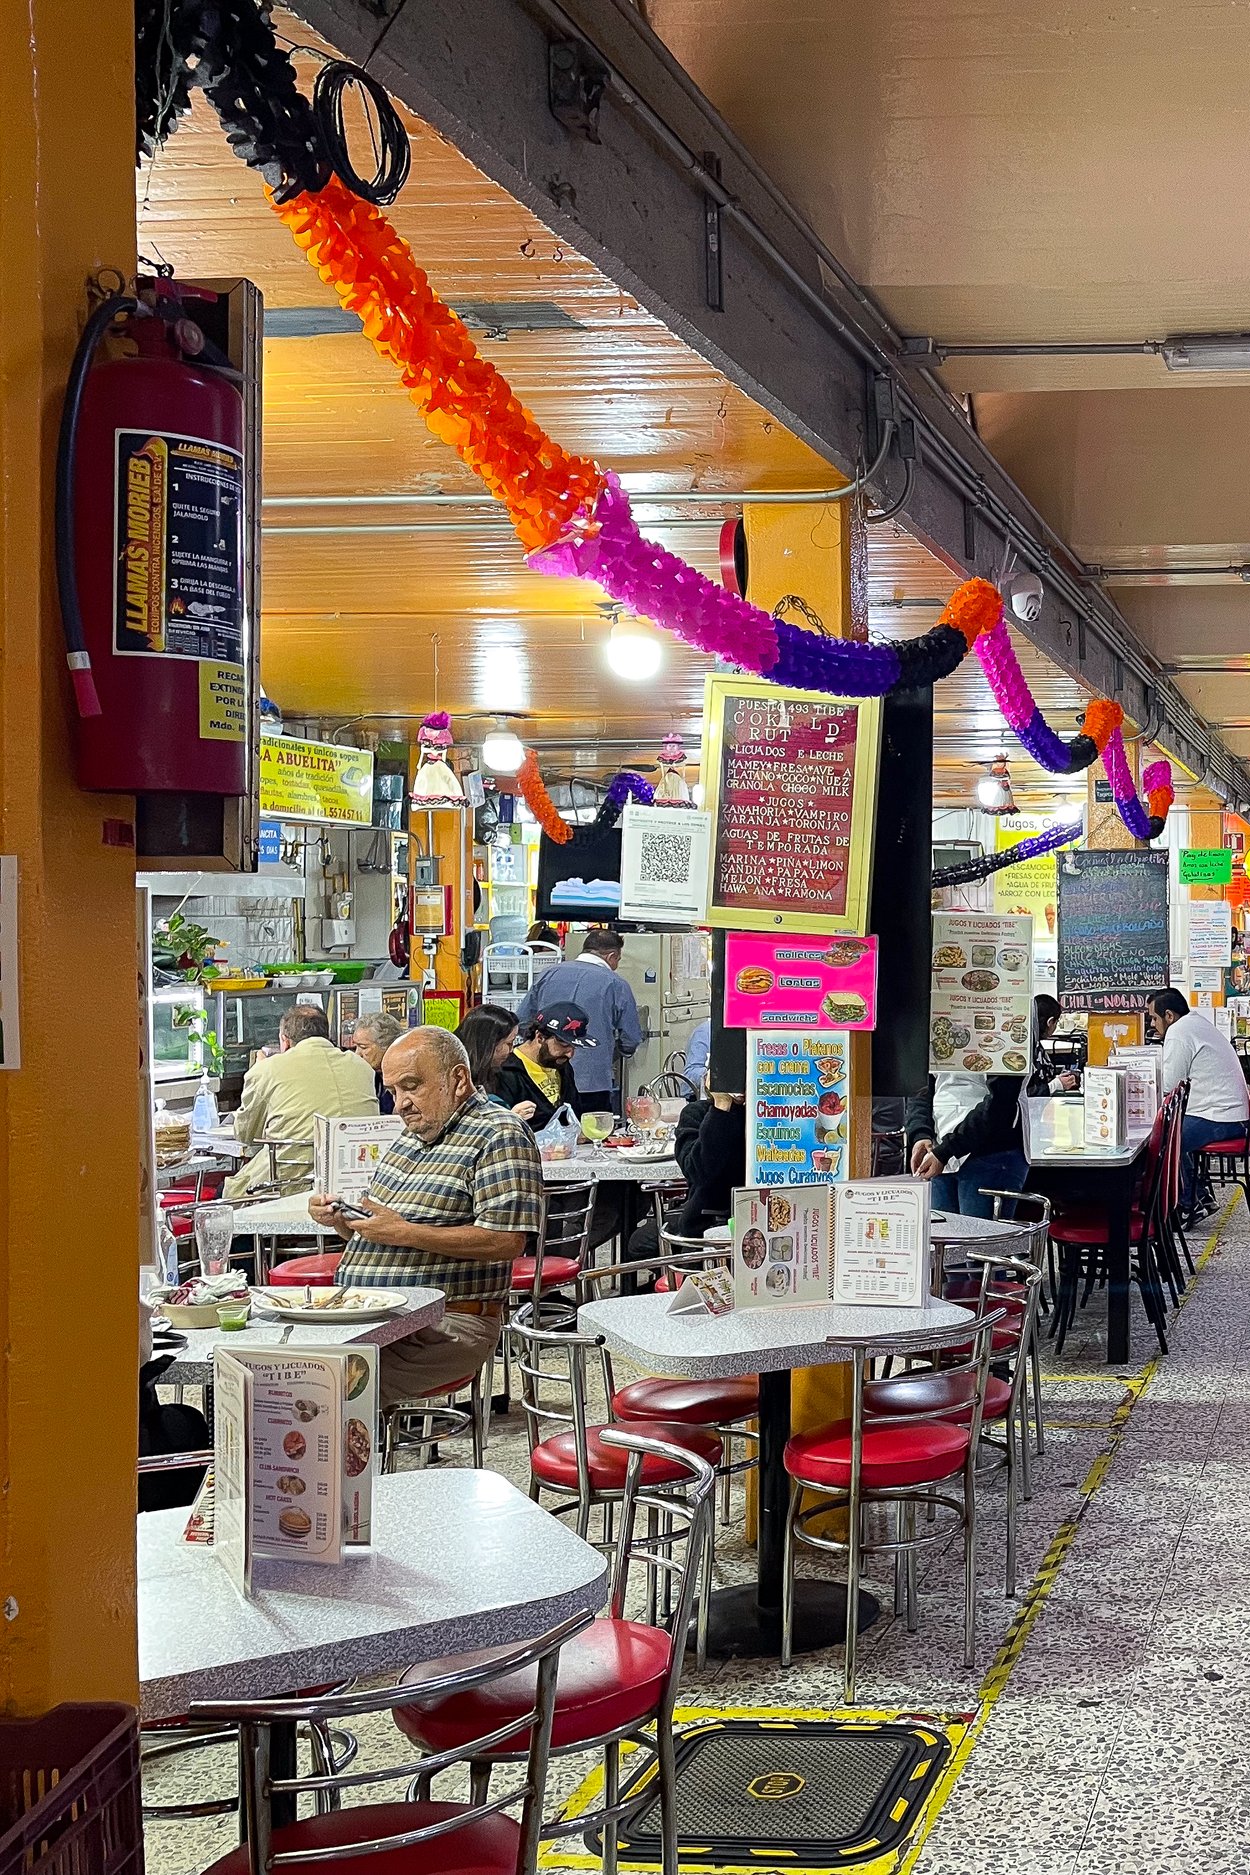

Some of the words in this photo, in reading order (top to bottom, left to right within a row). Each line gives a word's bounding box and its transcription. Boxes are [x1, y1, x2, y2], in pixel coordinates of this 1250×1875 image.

[173, 483, 179, 491] 1
[127, 457, 151, 541] MORIEB
[172, 503, 190, 511] QUITE
[171, 535, 179, 543] 2
[151, 563, 161, 593] CONTRA
[171, 578, 179, 588] 3
[126, 545, 150, 633] LLAMAS
[151, 595, 161, 633] EQUIPOS
[216, 696, 234, 704] POR
[738, 700, 783, 712] PUESTO
[788, 702, 809, 713] 493
[308, 747, 312, 755] y
[314, 744, 337, 758] únicos
[809, 750, 844, 761] LECHE
[726, 768, 775, 781] PLATANO
[780, 772, 810, 783] COCO
[726, 779, 775, 791] GRANOLA
[781, 783, 817, 795] CHOCO
[822, 785, 850, 797] MILK
[765, 796, 804, 808] JUGOS
[722, 804, 786, 817] ZANAHORIA
[794, 809, 849, 822] VAMPIRO
[721, 814, 781, 827] NARANJA
[789, 818, 841, 831] TORONJA
[1003, 817, 1037, 830] Jugos,
[721, 829, 759, 840] AGUAS
[766, 831, 781, 842] DE
[787, 833, 830, 845] FRUTAS
[836, 836, 850, 847] DE
[747, 839, 829, 856] TEMPORADA
[720, 864, 766, 876] SANDIA
[808, 859, 844, 872] LIMON
[720, 873, 762, 885] MELON
[771, 876, 808, 889] FRESA
[784, 889, 833, 901] RAMONA
[1060, 994, 1094, 1008] CHILE
[761, 1012, 818, 1023] sandwichs
[756, 1038, 788, 1056] Fresas
[757, 1061, 776, 1074] con
[778, 1061, 809, 1074] crema
[756, 1079, 816, 1096] Escamochas
[756, 1101, 818, 1122] Chamoyadas
[756, 1123, 801, 1144] Esquimos
[756, 1167, 784, 1186] Jugos
[789, 1167, 834, 1185] Curativos
[282, 1362, 325, 1371] LICUADOS
